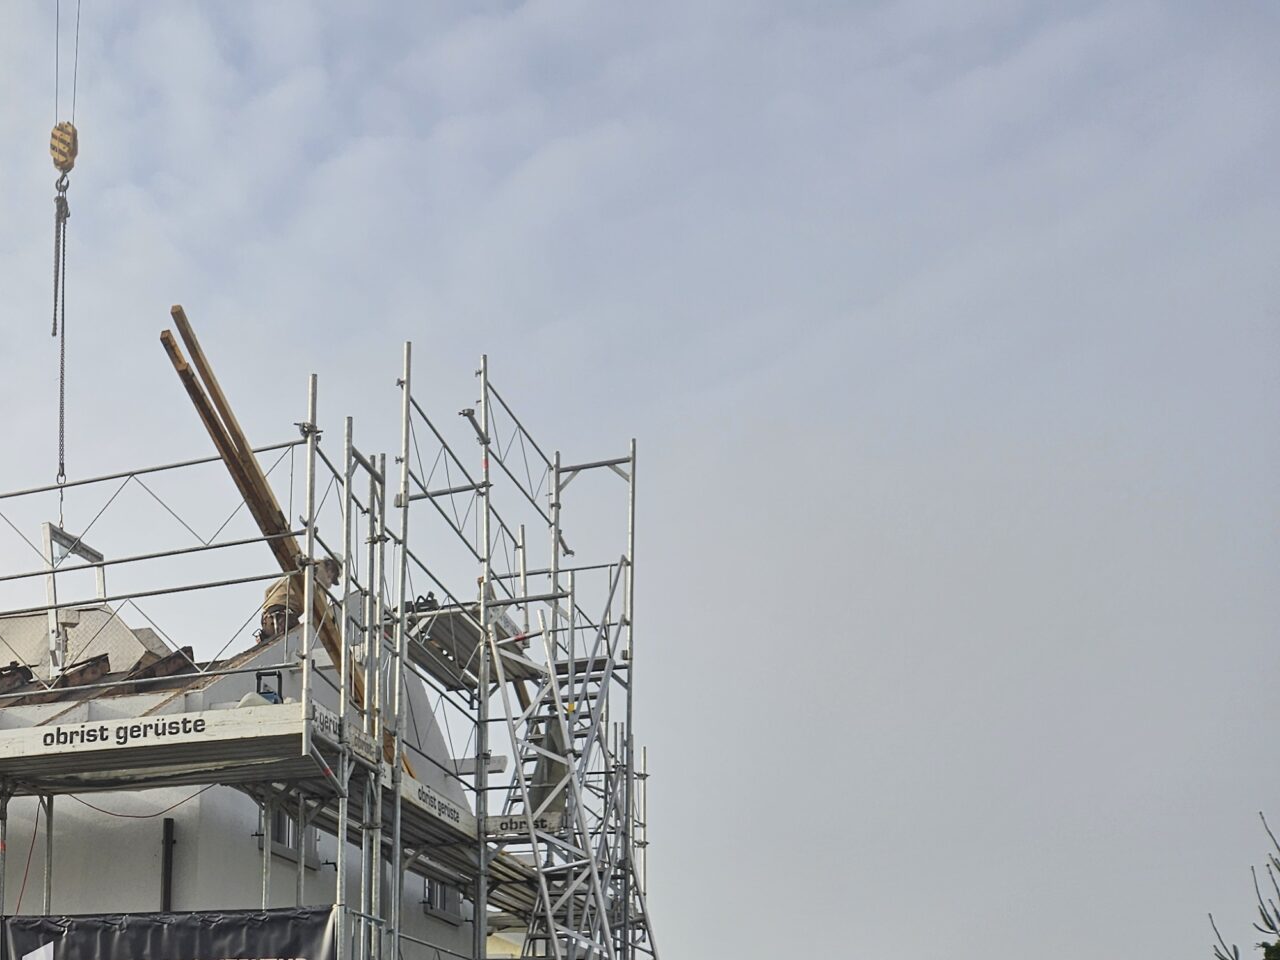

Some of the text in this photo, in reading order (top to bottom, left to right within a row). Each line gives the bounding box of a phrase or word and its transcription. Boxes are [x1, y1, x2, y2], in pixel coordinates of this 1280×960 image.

[43, 716, 206, 746] obrist gerüste
[499, 818, 548, 831] obrst
